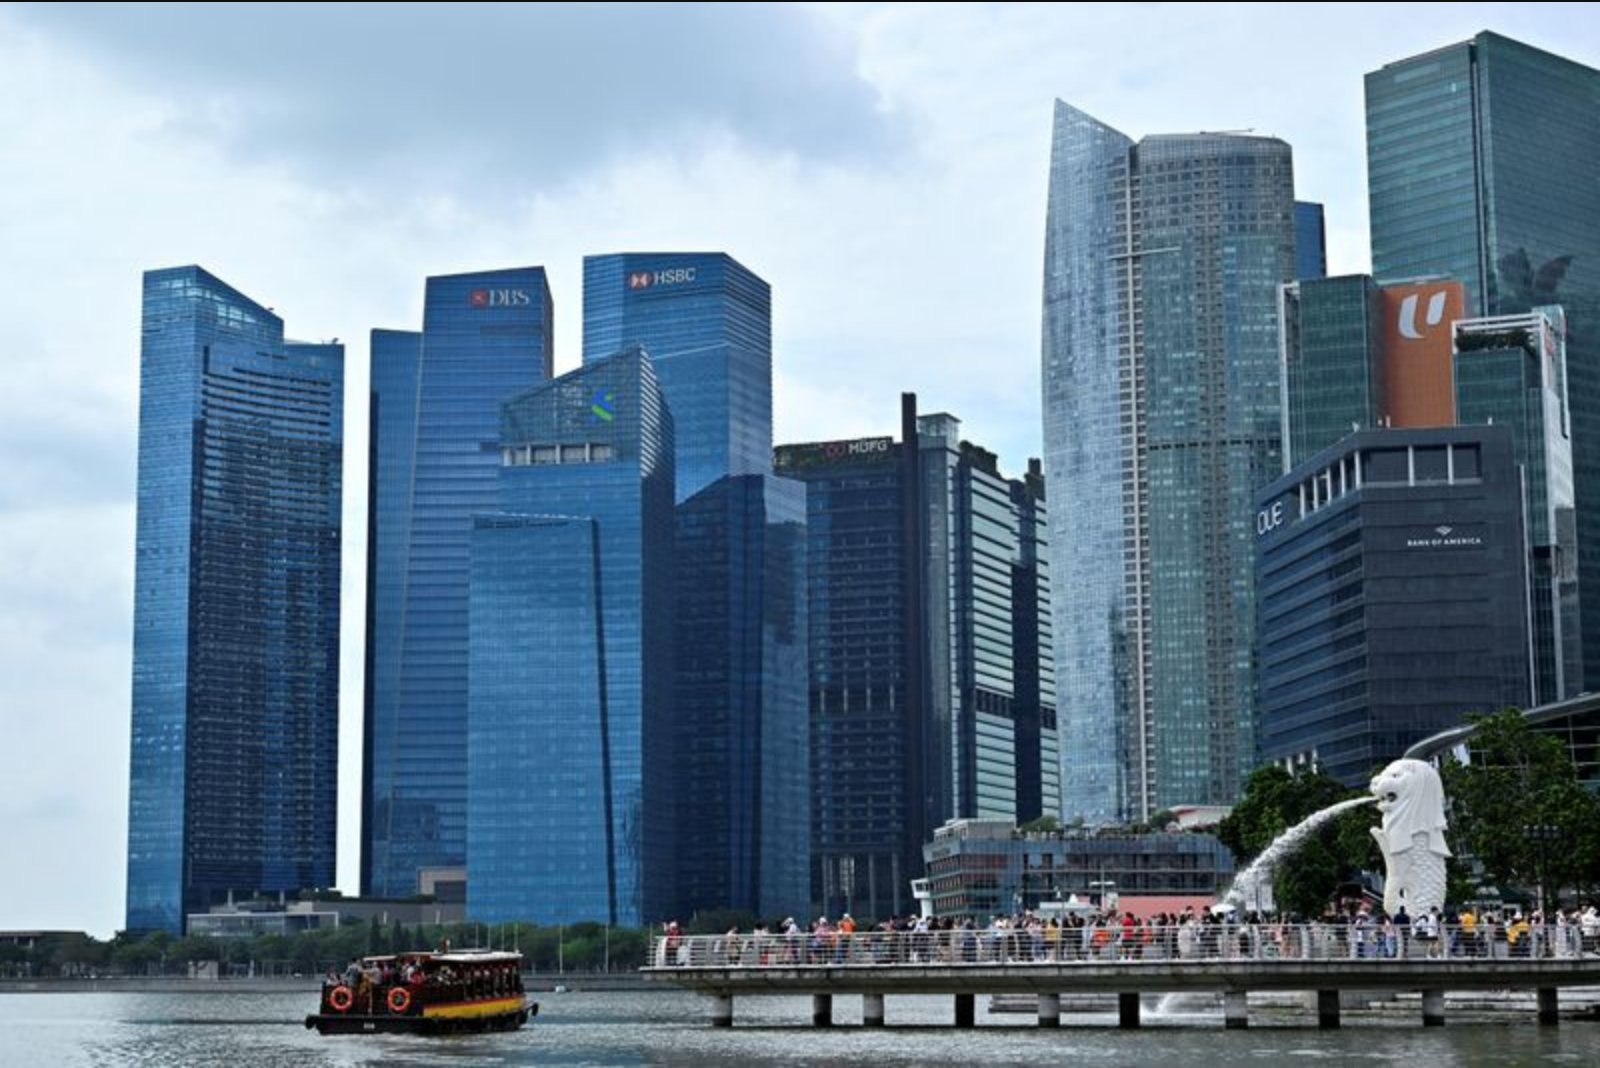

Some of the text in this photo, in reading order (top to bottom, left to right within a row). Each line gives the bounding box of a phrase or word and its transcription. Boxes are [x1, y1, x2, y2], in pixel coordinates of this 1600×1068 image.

[654, 267, 697, 285] HSBC
[489, 289, 530, 306] DBS
[1257, 501, 1282, 535] OUE
[1407, 536, 1482, 547] BANK OF AMERICA
